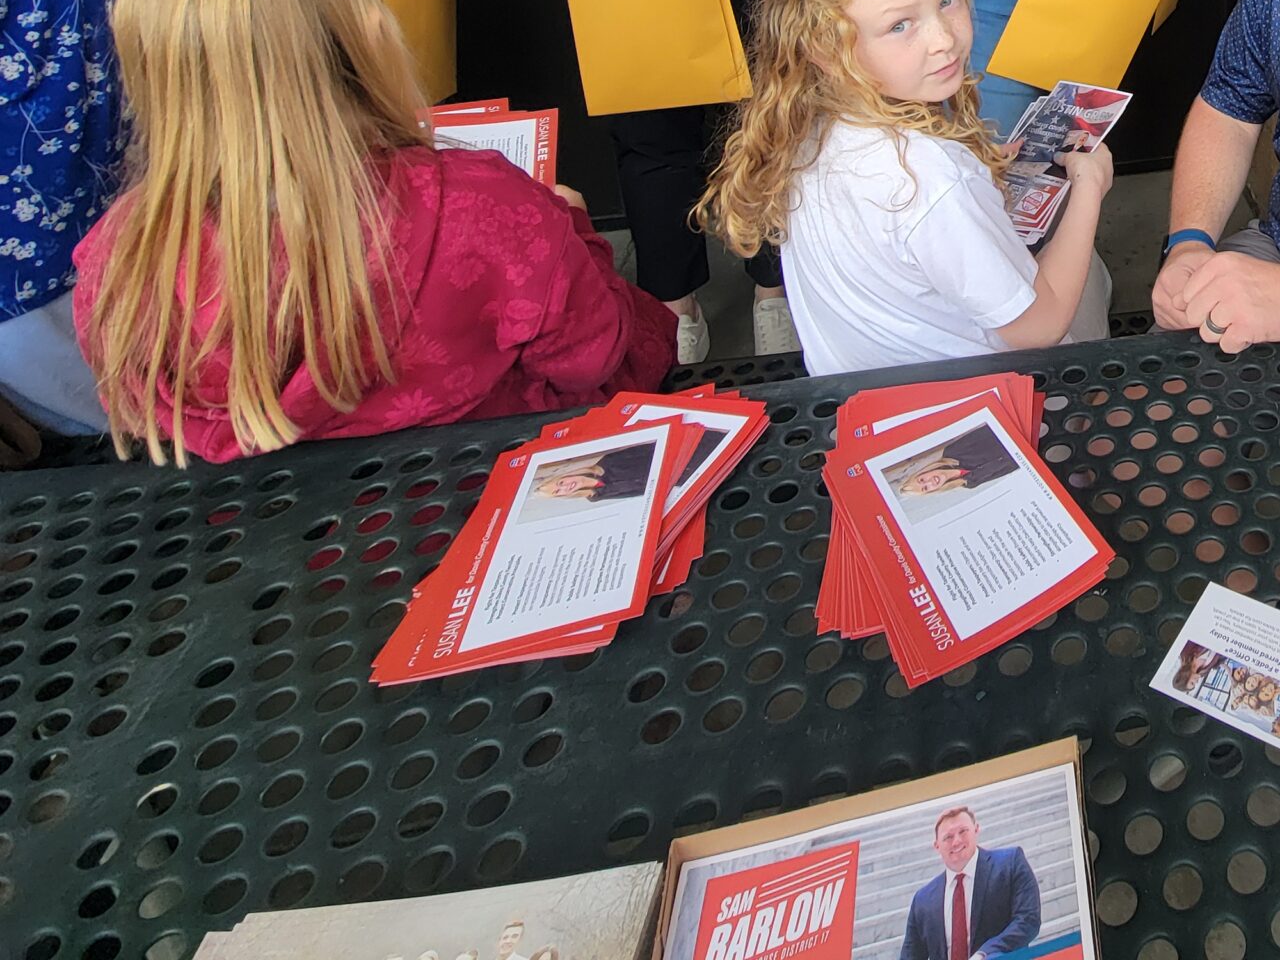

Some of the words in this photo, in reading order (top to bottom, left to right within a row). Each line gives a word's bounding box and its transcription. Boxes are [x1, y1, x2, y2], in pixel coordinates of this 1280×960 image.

[538, 116, 548, 140] SUSAN
[537, 141, 548, 161] LEE
[875, 514, 897, 547] Commissioner
[475, 540, 489, 560] County
[891, 544, 906, 563] County
[464, 575, 475, 584] for
[899, 561, 913, 577] Davis
[906, 575, 917, 585] for
[447, 585, 476, 619] LEE
[908, 582, 936, 616] LEE
[431, 617, 464, 659] SUSAN
[922, 610, 954, 652] SUSAN
[1208, 627, 1230, 642] today
[1229, 638, 1259, 655] member
[1250, 657, 1273, 672] FedEx
[716, 887, 757, 922] SAM
[704, 877, 846, 960] BARLOW
[780, 937, 819, 960] DISTRICT
[820, 930, 830, 945] 17
